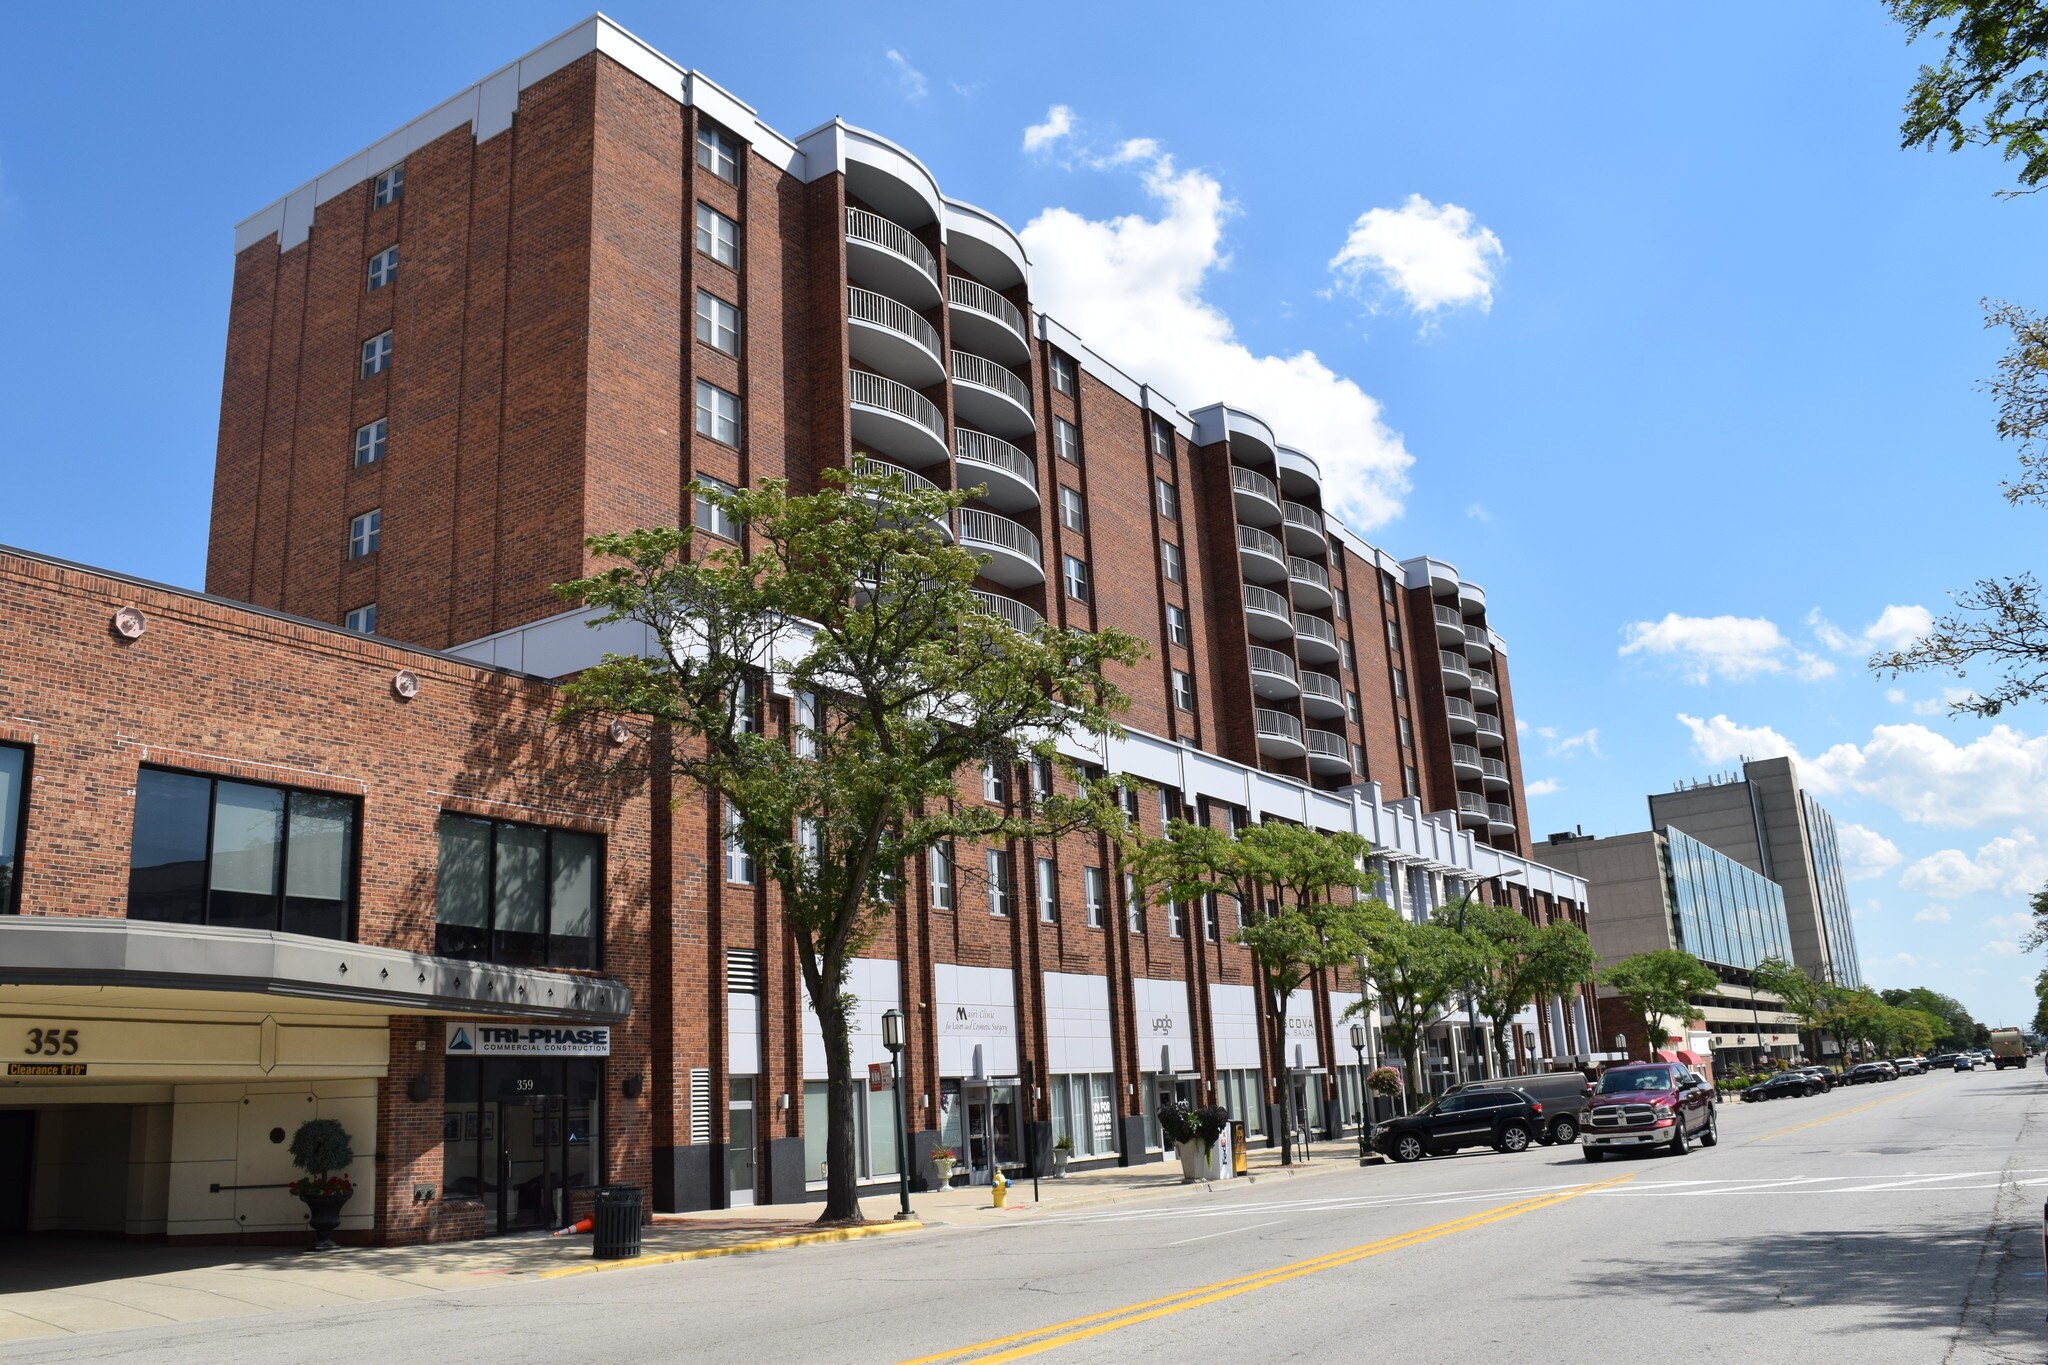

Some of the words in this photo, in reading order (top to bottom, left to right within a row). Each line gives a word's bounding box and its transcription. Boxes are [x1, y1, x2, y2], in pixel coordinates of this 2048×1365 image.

[979, 1009, 995, 1019] Clinic
[1152, 1014, 1173, 1036] yoga
[24, 1028, 79, 1056] 355
[479, 1027, 608, 1044] TRI-PHASE
[10, 1064, 58, 1075] Clearance
[516, 1079, 534, 1091] 359
